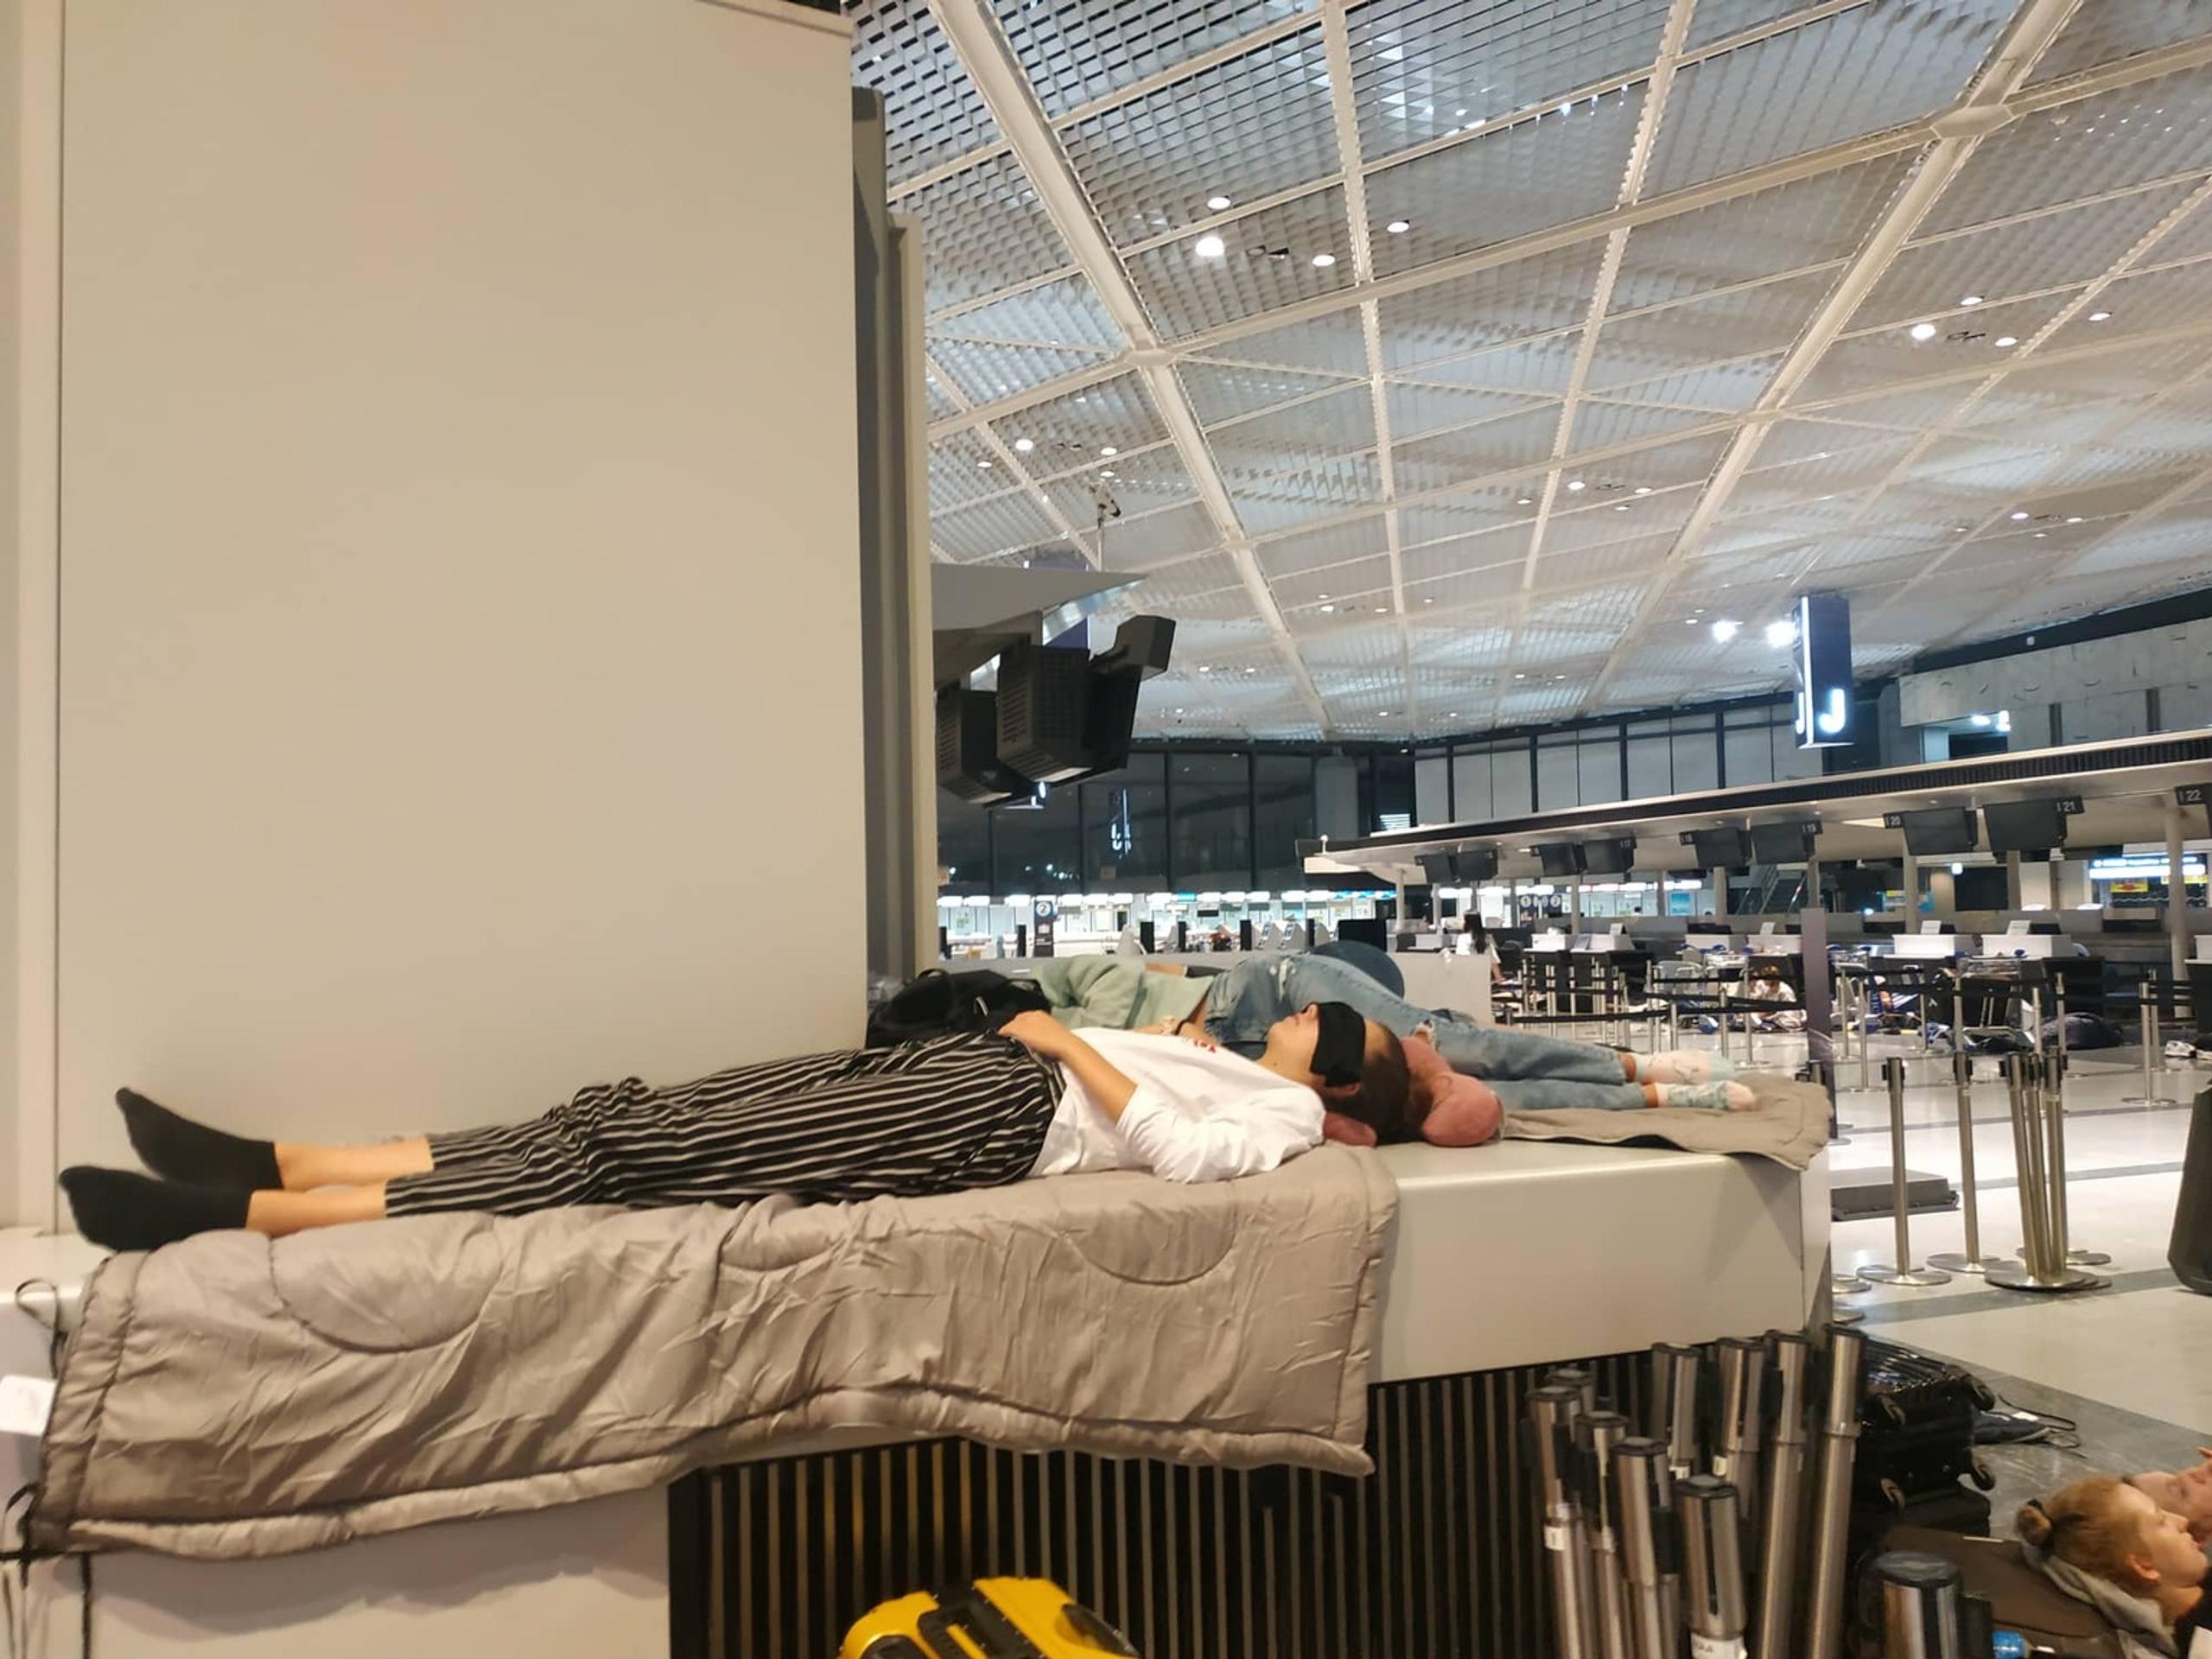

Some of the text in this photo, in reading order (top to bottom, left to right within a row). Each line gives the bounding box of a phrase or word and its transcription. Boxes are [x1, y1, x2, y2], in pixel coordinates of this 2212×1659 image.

[1818, 688, 1847, 734] J
[2186, 789, 2202, 801] 22
[2063, 801, 2075, 812] 21
[1890, 815, 1901, 825] 20
